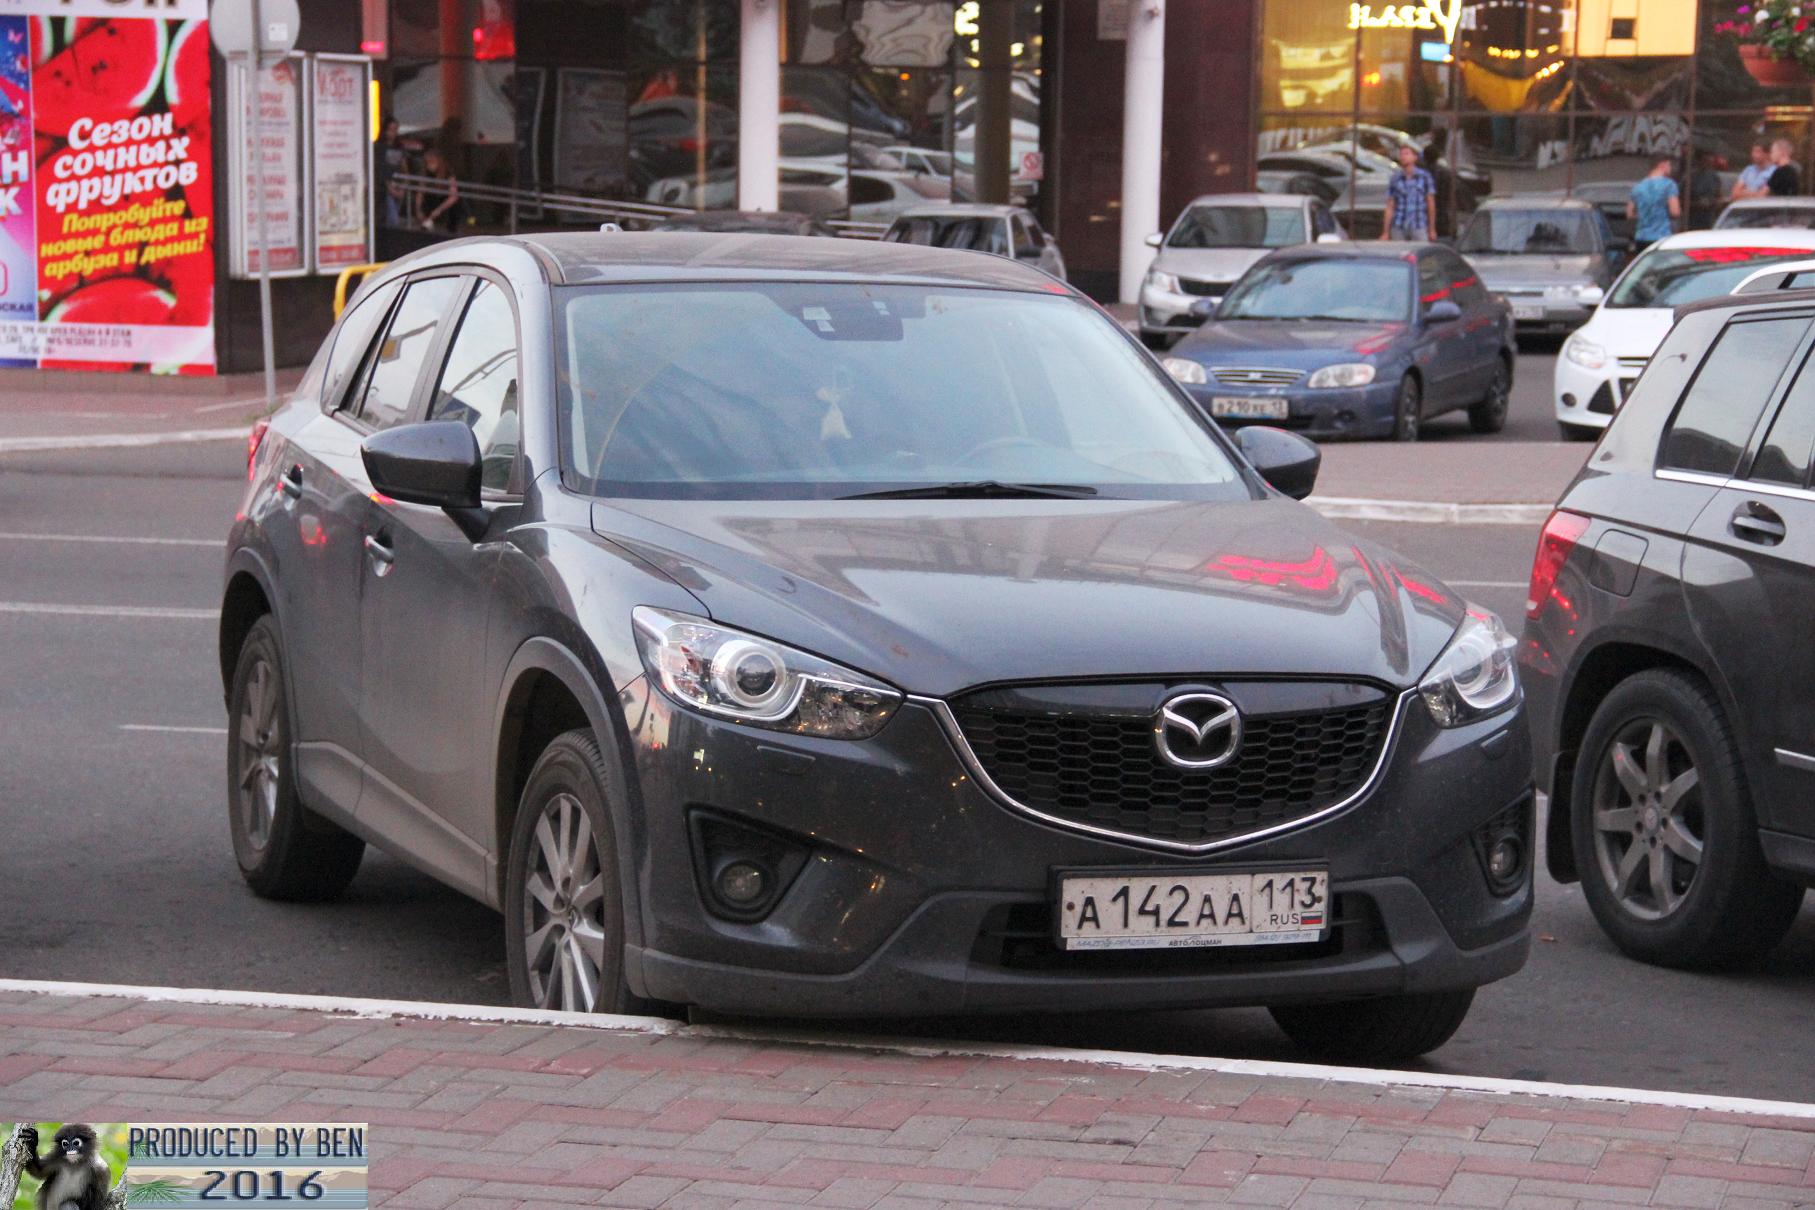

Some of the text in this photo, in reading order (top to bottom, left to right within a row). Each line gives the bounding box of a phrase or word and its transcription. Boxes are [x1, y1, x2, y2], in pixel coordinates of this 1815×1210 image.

[68, 112, 173, 150] Сезон
[53, 136, 190, 179] сочных
[46, 161, 198, 213] фруктов
[62, 197, 186, 234] Попробуйте
[40, 217, 208, 257] новые блюда из
[44, 233, 206, 280] арбуза и дыни!
[1077, 876, 1317, 930] A142AA 113
[1270, 913, 1300, 925] RUS
